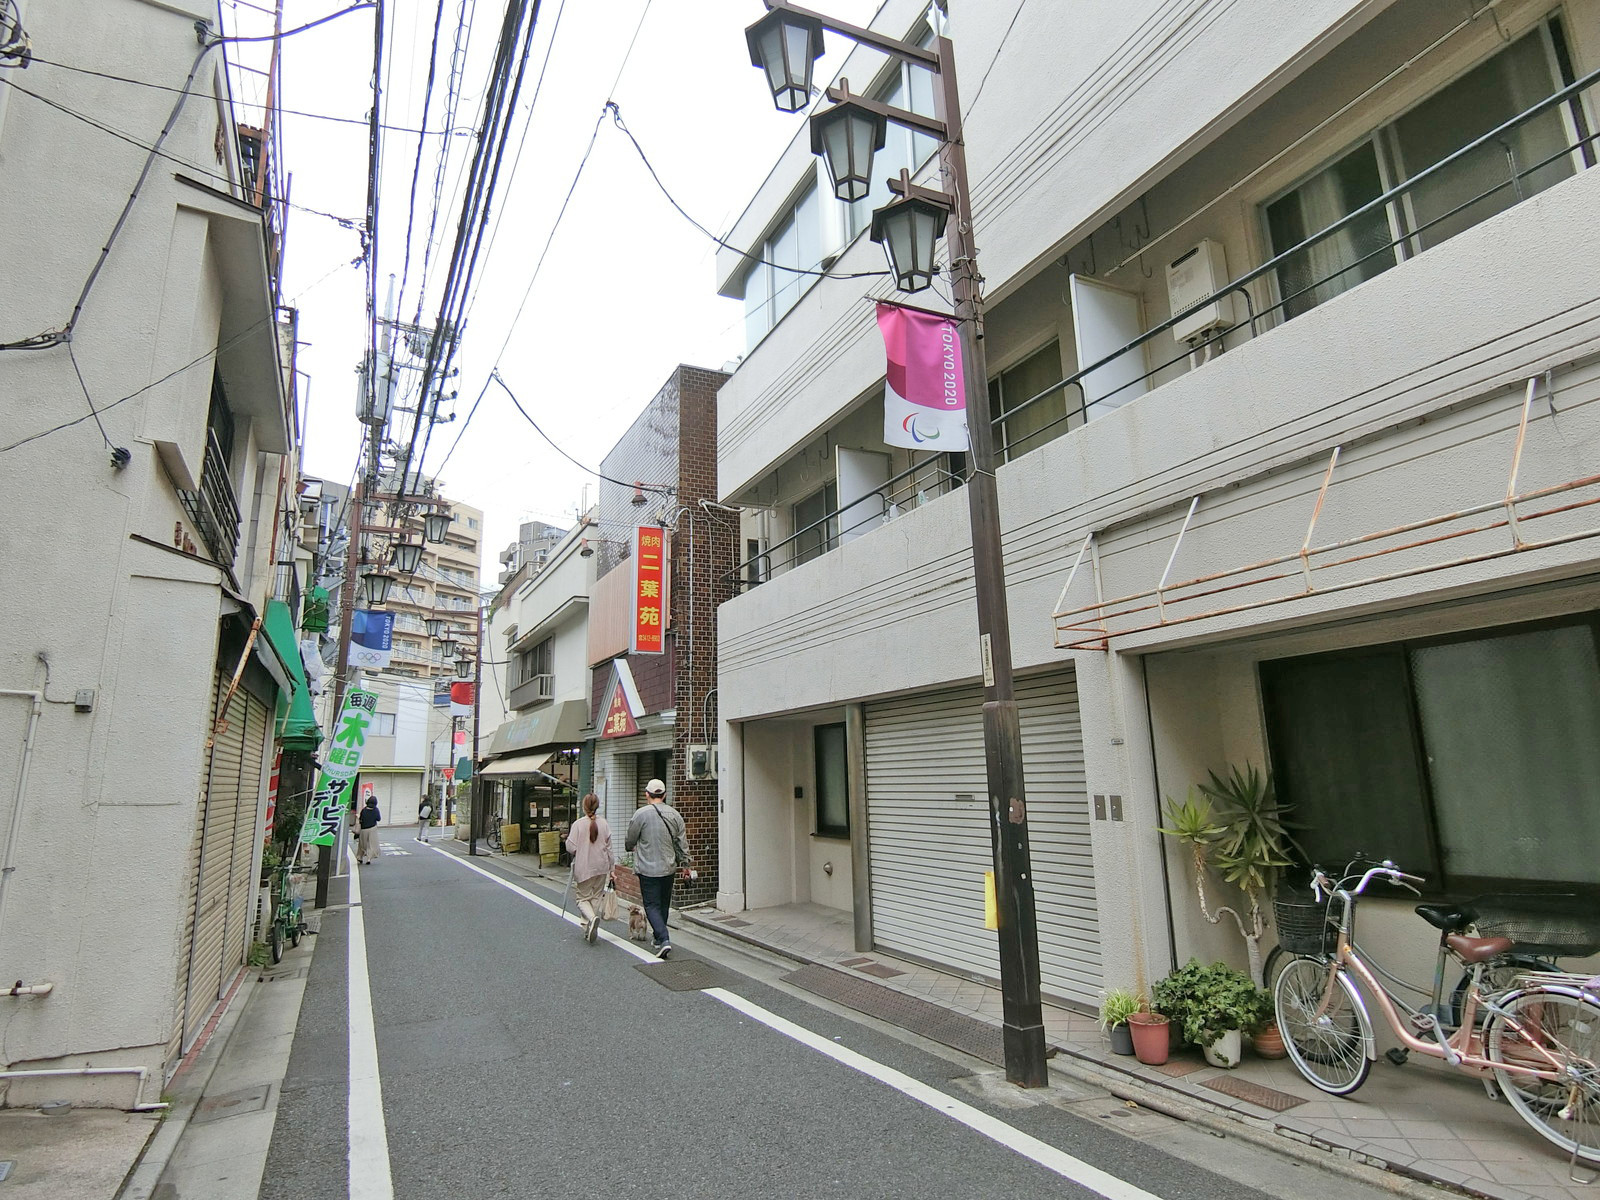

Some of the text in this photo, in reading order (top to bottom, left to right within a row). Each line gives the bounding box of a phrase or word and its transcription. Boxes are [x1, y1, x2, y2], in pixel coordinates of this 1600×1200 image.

[941, 326, 958, 406] TOKYO 2020
[641, 535, 661, 548] 焼肉
[640, 554, 660, 626] 二葉苑
[382, 616, 392, 649] TOKYO 2020
[350, 692, 378, 712] 毎週
[335, 712, 370, 748] 木
[322, 764, 357, 777] THURSDAY
[328, 747, 361, 768] 曜日
[312, 790, 332, 819] デー
[318, 779, 349, 837] サービス
